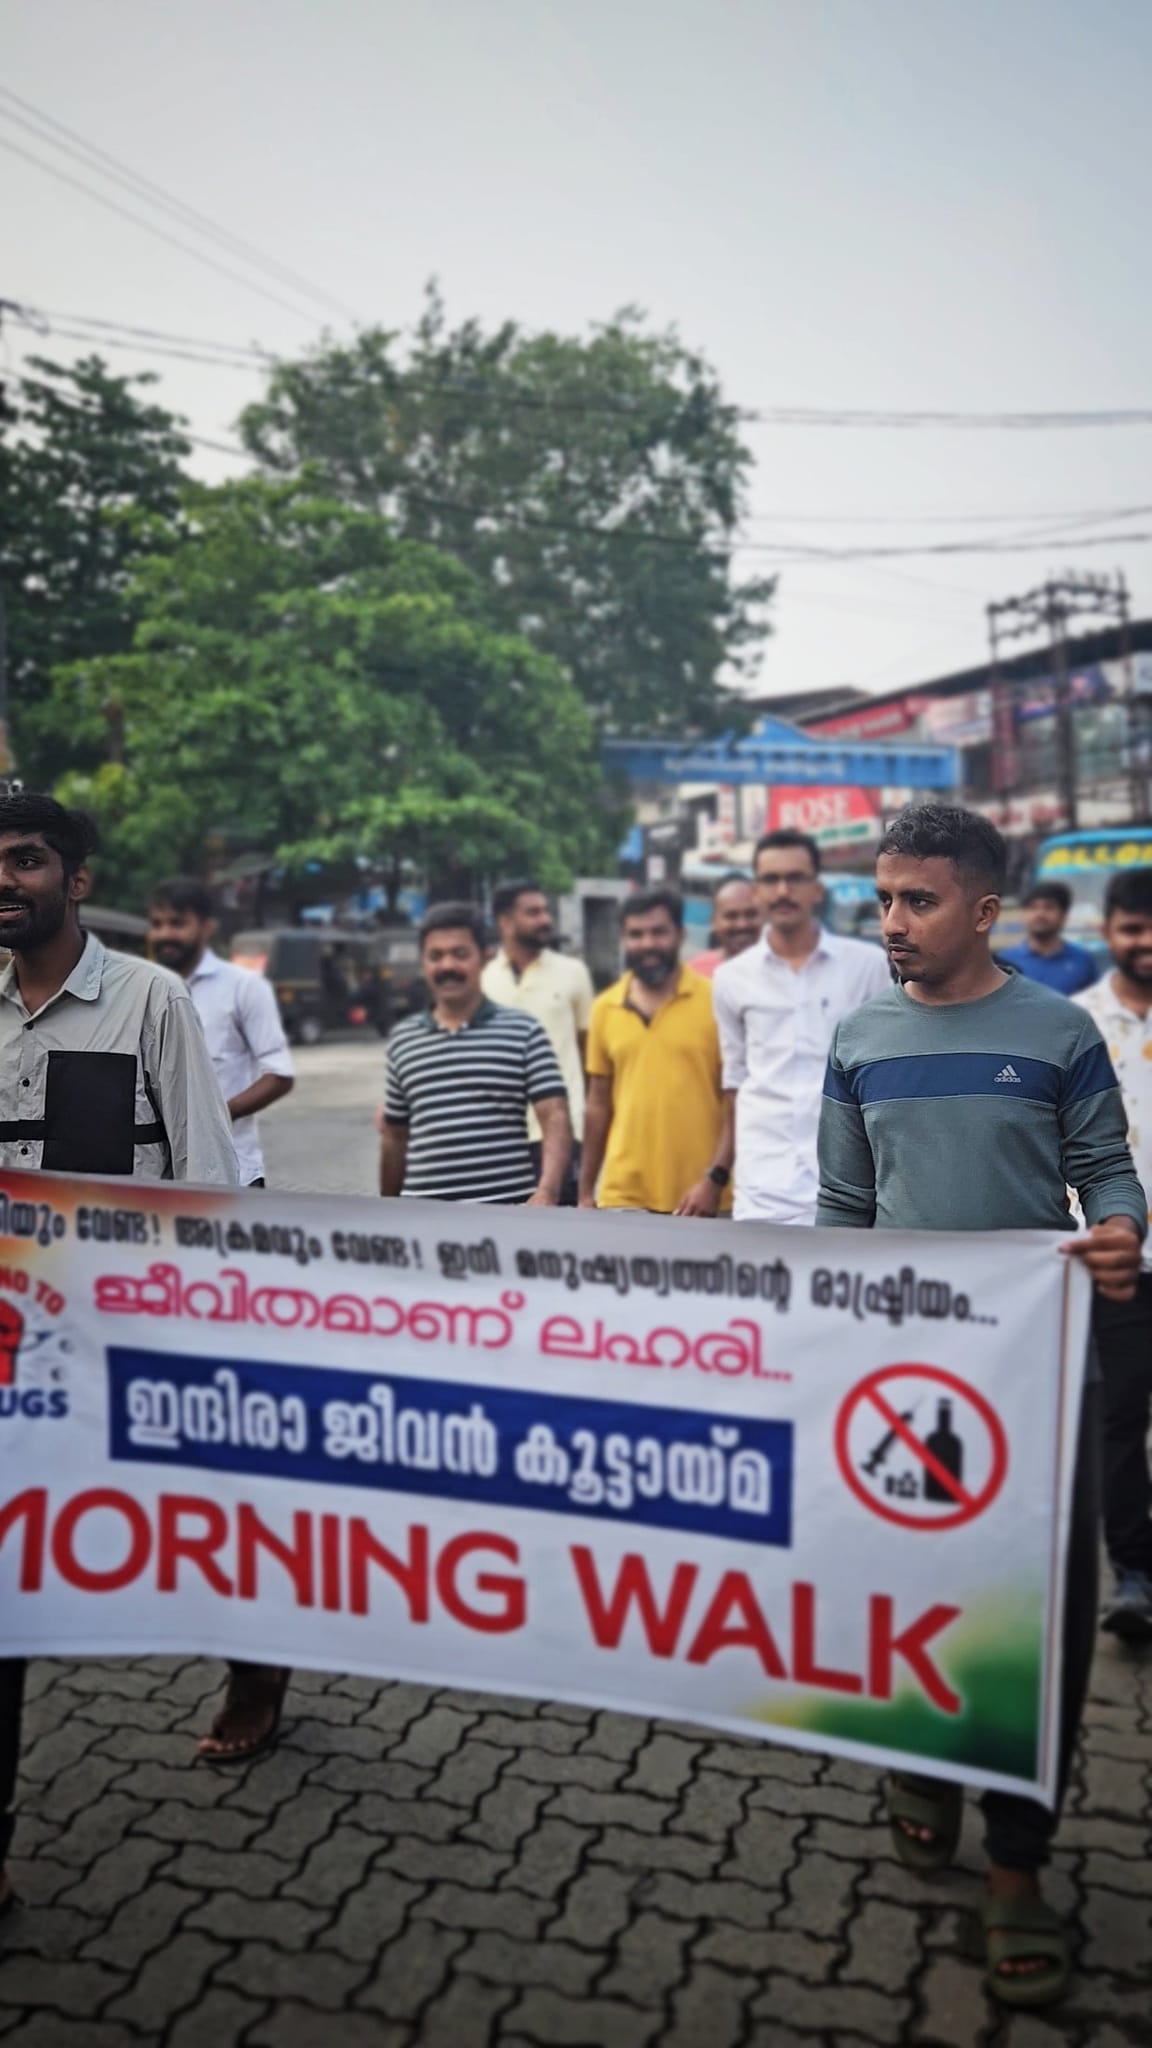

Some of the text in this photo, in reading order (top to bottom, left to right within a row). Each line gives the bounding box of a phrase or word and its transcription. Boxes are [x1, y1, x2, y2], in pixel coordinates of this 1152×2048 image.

[36, 1280, 66, 1317] TO
[174, 1216, 323, 1267] അക്രമവും
[437, 1237, 502, 1281] ഇനി
[94, 1262, 793, 1382] ജീവിതമാണ് ലഹരി...
[126, 1368, 771, 1515] ഇന്ദിരാ ജീവൻ കൂട്ടായ്മ
[569, 1543, 962, 1716] WALK
